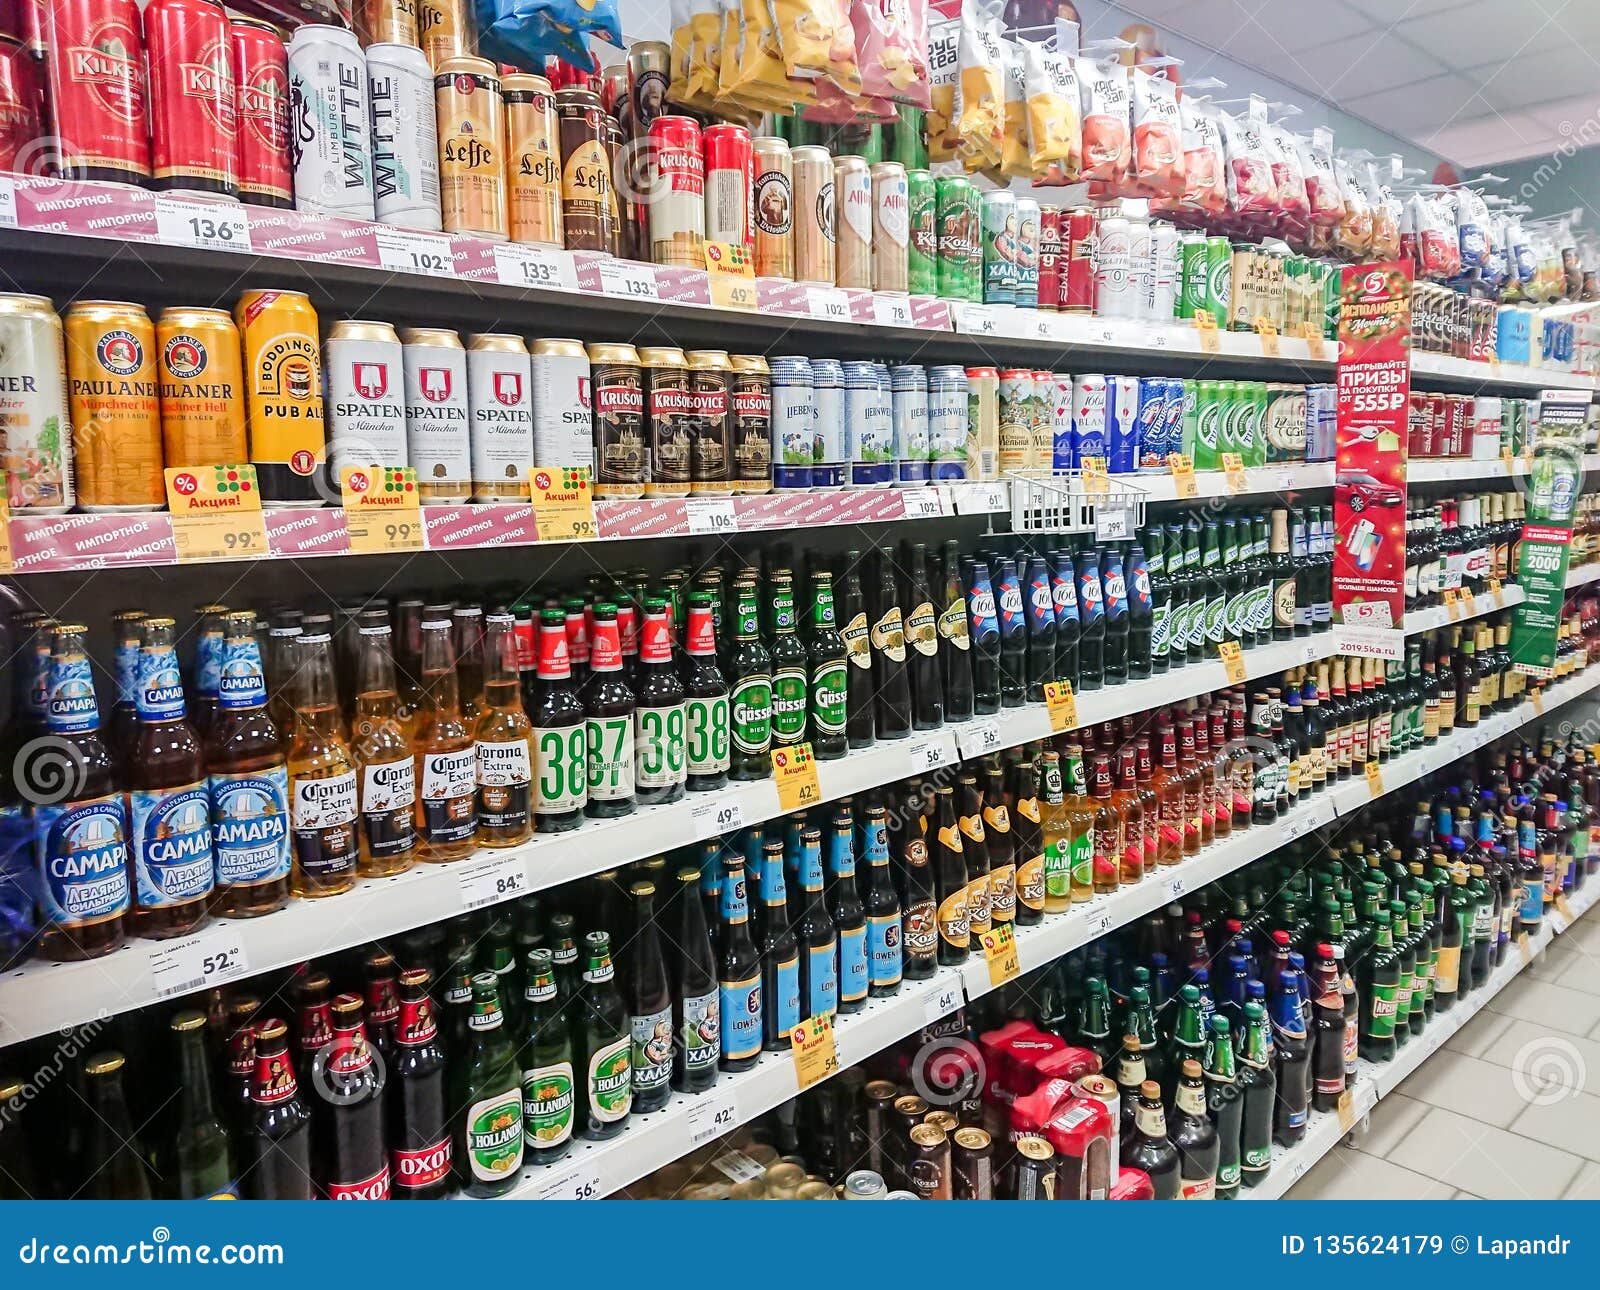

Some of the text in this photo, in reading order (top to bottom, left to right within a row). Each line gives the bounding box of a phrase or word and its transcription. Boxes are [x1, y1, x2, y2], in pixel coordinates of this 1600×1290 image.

[327, 86, 341, 164] LIMBURGSE
[339, 63, 364, 189] WITTE
[371, 77, 397, 200] WITTE
[444, 138, 492, 169] Leffe
[519, 153, 560, 184] Leffe
[36, 193, 114, 213] ИМПОРТНОЕ
[189, 217, 234, 242] 136
[265, 231, 327, 249] ИМПОРТНОЕ
[520, 261, 550, 280] 133
[717, 263, 746, 275] Акция!
[1340, 360, 1407, 374] ВЫИГРЫВАЙТЕ
[1340, 370, 1407, 387] ПРИЗЫ
[1340, 385, 1398, 395] ЗА ПОКУПКИ
[1339, 395, 1352, 403] ОТ
[204, 401, 228, 413] Hell
[264, 405, 300, 418] PUB
[336, 403, 403, 418] SPATEN
[405, 406, 466, 420] SPATEN
[348, 420, 394, 432] München
[414, 422, 458, 433] München
[487, 424, 527, 435] München
[189, 494, 241, 509] Акция!
[360, 494, 404, 505] Акция!
[544, 491, 579, 502] Акция!
[603, 506, 642, 527] ИМПОРТНОЕ
[629, 512, 668, 534] ИМПОРТНОЕ
[24, 514, 102, 542] ИМПОРТНОЕ
[384, 523, 411, 541] 99
[443, 519, 493, 544] ИМПОРТНОЕ
[75, 521, 149, 551] ИМПОРТНОЕ
[1527, 555, 1560, 571] 2000
[1340, 643, 1396, 656] 2019.5ka.ru
[221, 677, 262, 690] САМАРА
[52, 698, 97, 713] САМАРА
[1063, 716, 1073, 726] 69
[687, 699, 728, 763] 38
[749, 726, 765, 734] BIER
[983, 731, 995, 744] 56
[641, 709, 684, 776] 38
[540, 726, 585, 800] 38
[926, 749, 939, 762] 56
[483, 760, 512, 770] Extra
[784, 765, 807, 777] Акция!
[799, 786, 813, 799] 42
[321, 797, 352, 811] Extra
[716, 807, 732, 824] 49
[212, 816, 285, 843] САМАРА
[220, 849, 278, 867] ЛЕДЯНАЯ
[228, 947, 239, 956] 40
[1004, 959, 1016, 973] 44
[939, 995, 951, 1008] 64
[920, 1016, 965, 1045] Kozel
[801, 1034, 825, 1052] Акция!
[524, 1093, 571, 1115] HOLLANDIA
